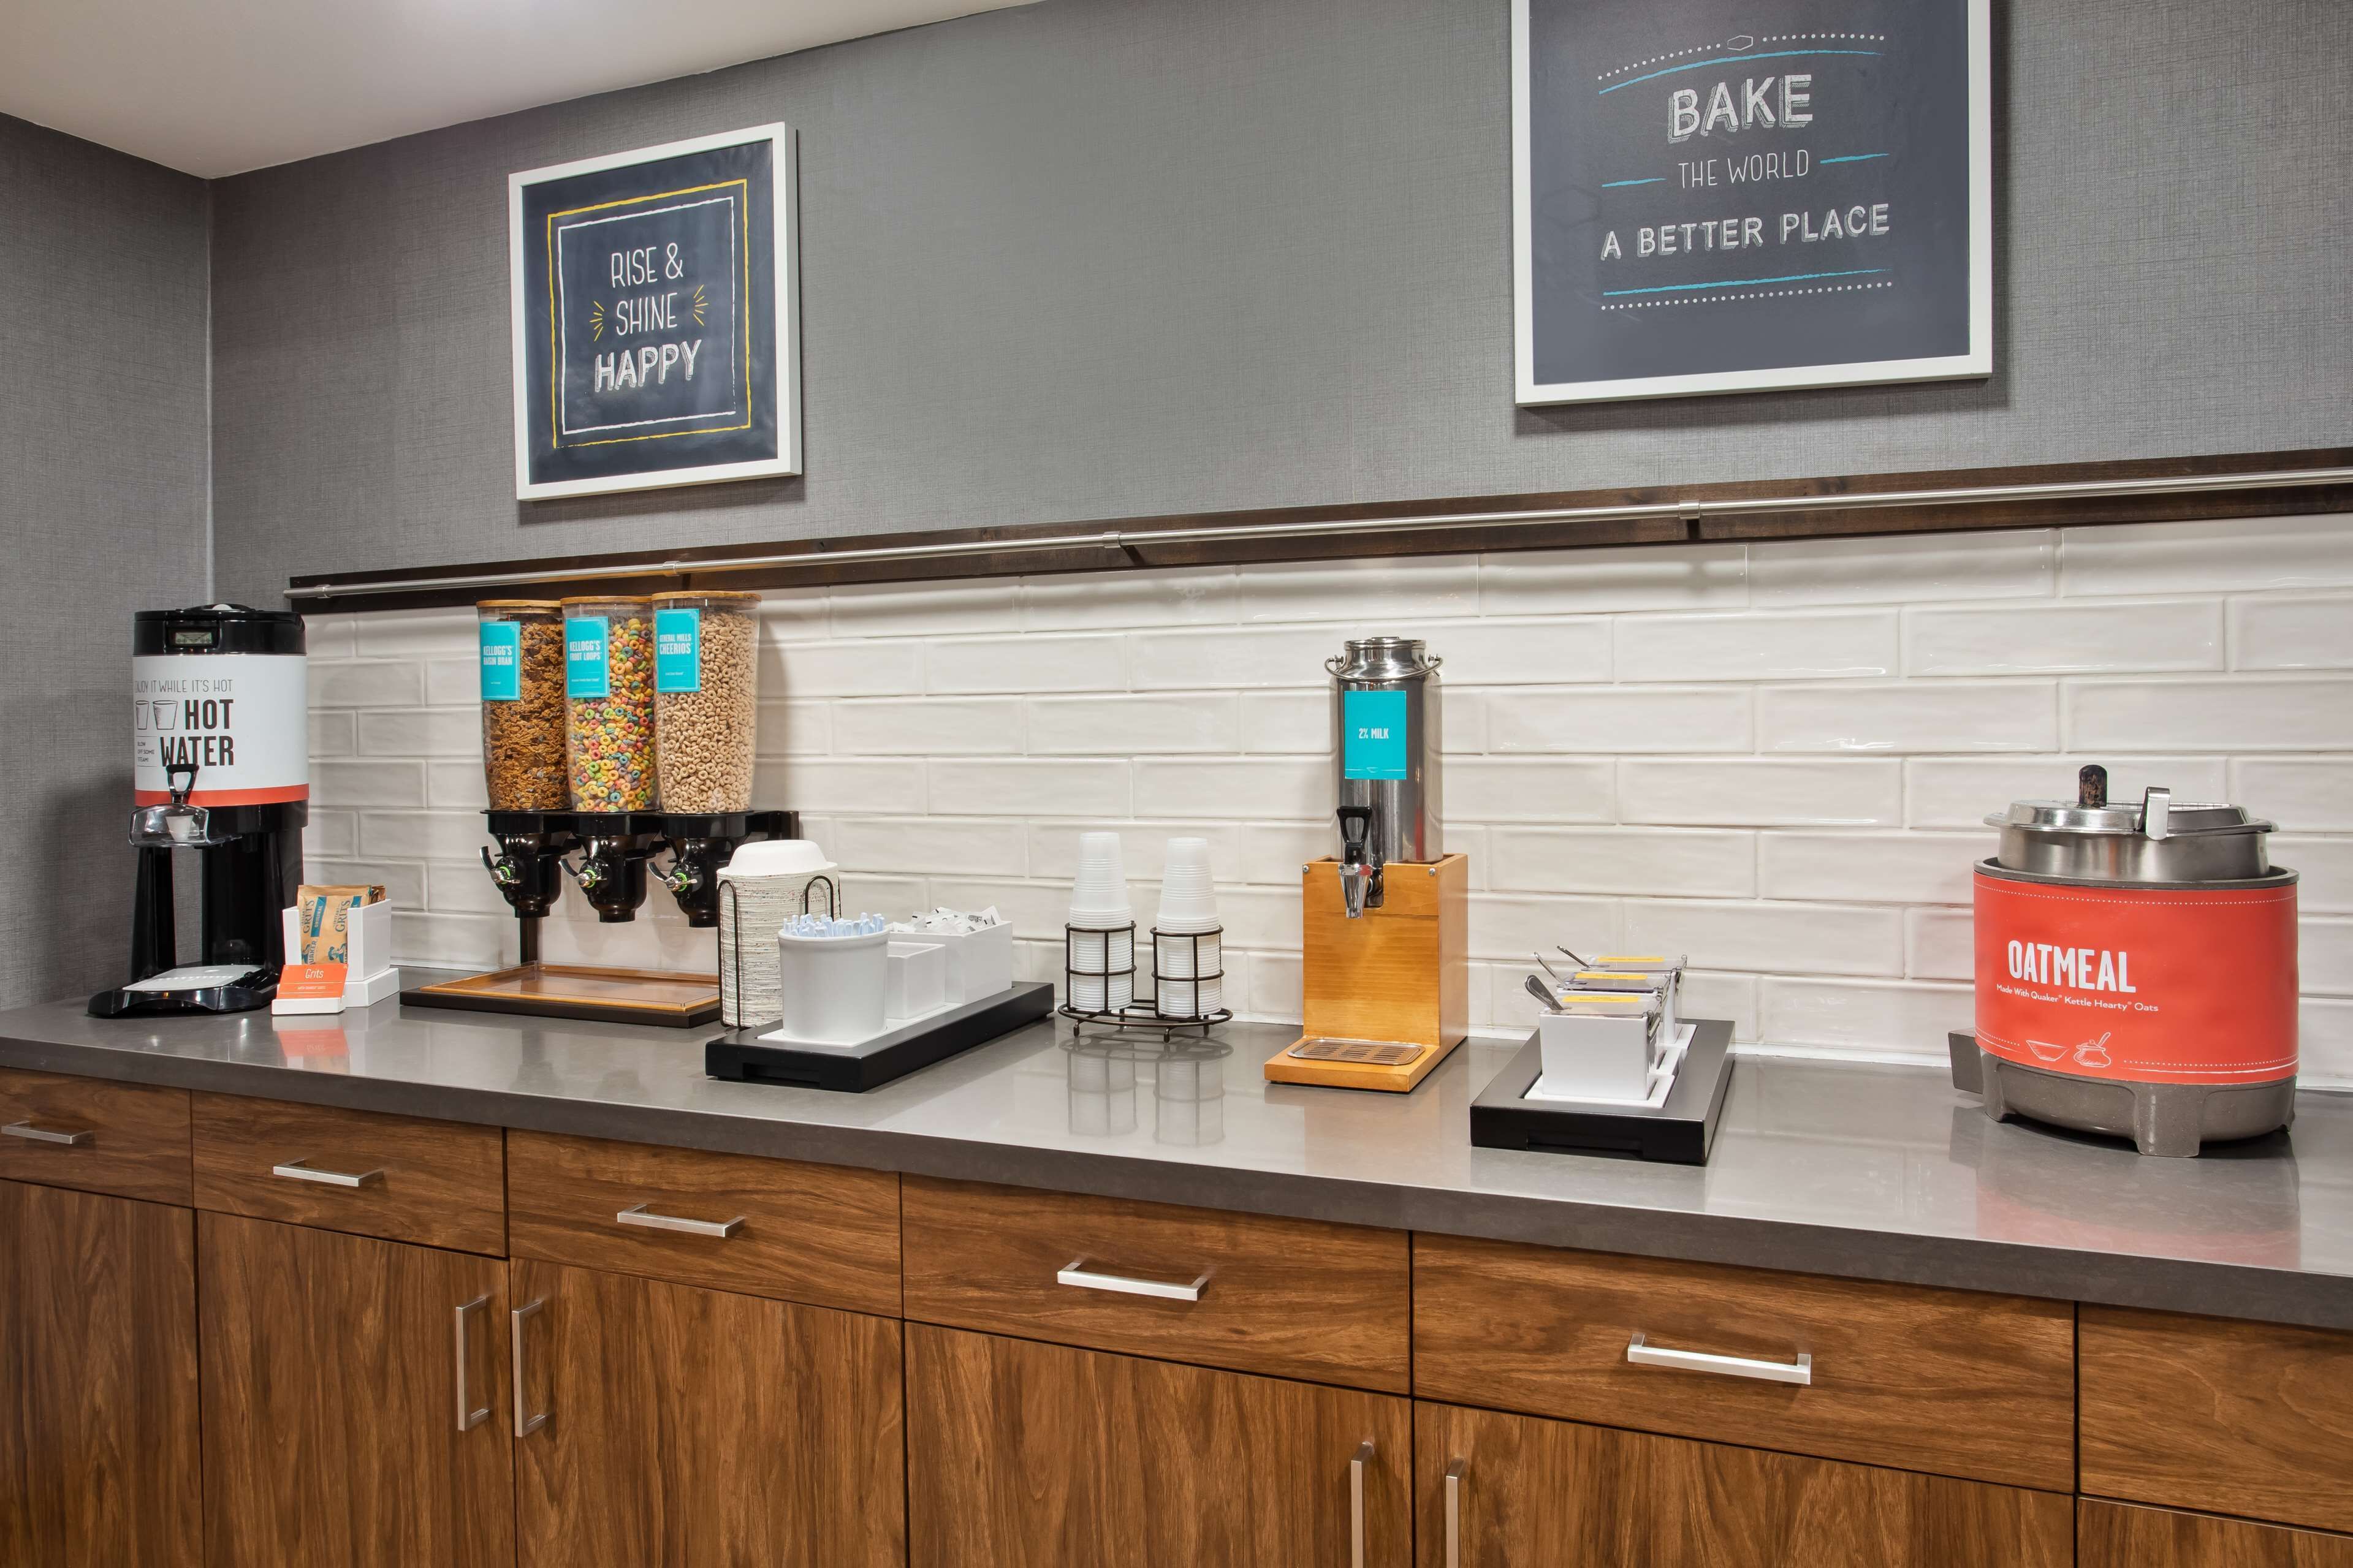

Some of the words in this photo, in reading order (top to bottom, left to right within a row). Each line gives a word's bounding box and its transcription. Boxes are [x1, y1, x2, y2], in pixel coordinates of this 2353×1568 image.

[1667, 74, 1813, 143] BAKE
[1678, 159, 1717, 189] THE
[1727, 150, 1809, 182] WORLD
[1600, 230, 1621, 260] A
[1637, 217, 1763, 257] BETTER
[1780, 203, 1890, 243] PLACE
[611, 246, 657, 288] RISE
[665, 243, 683, 280] &
[616, 292, 678, 336] SHINE
[595, 339, 702, 392] HAPPY
[569, 640, 601, 651] KELLOGG'S
[659, 642, 691, 655] CHEERIOS
[677, 633, 691, 642] MILLS
[151, 680, 157, 693] IT
[159, 680, 187, 693] WHILE
[192, 680, 209, 692] IT'S
[214, 679, 233, 692] HOT
[184, 699, 234, 730] HOT
[1358, 728, 1368, 739] 2%
[1370, 728, 1389, 739] MILK
[160, 735, 234, 767] WATER
[303, 900, 315, 933] GRITS
[314, 906, 324, 928] ORIGINAL
[335, 900, 351, 932] GRITS
[305, 968, 324, 979] Grits
[2008, 940, 2136, 993] OATMEAL
[1996, 983, 2013, 994] Made
[2014, 987, 2029, 998] With
[2064, 996, 2092, 1007] Kettle
[2135, 1003, 2159, 1012] Oats
